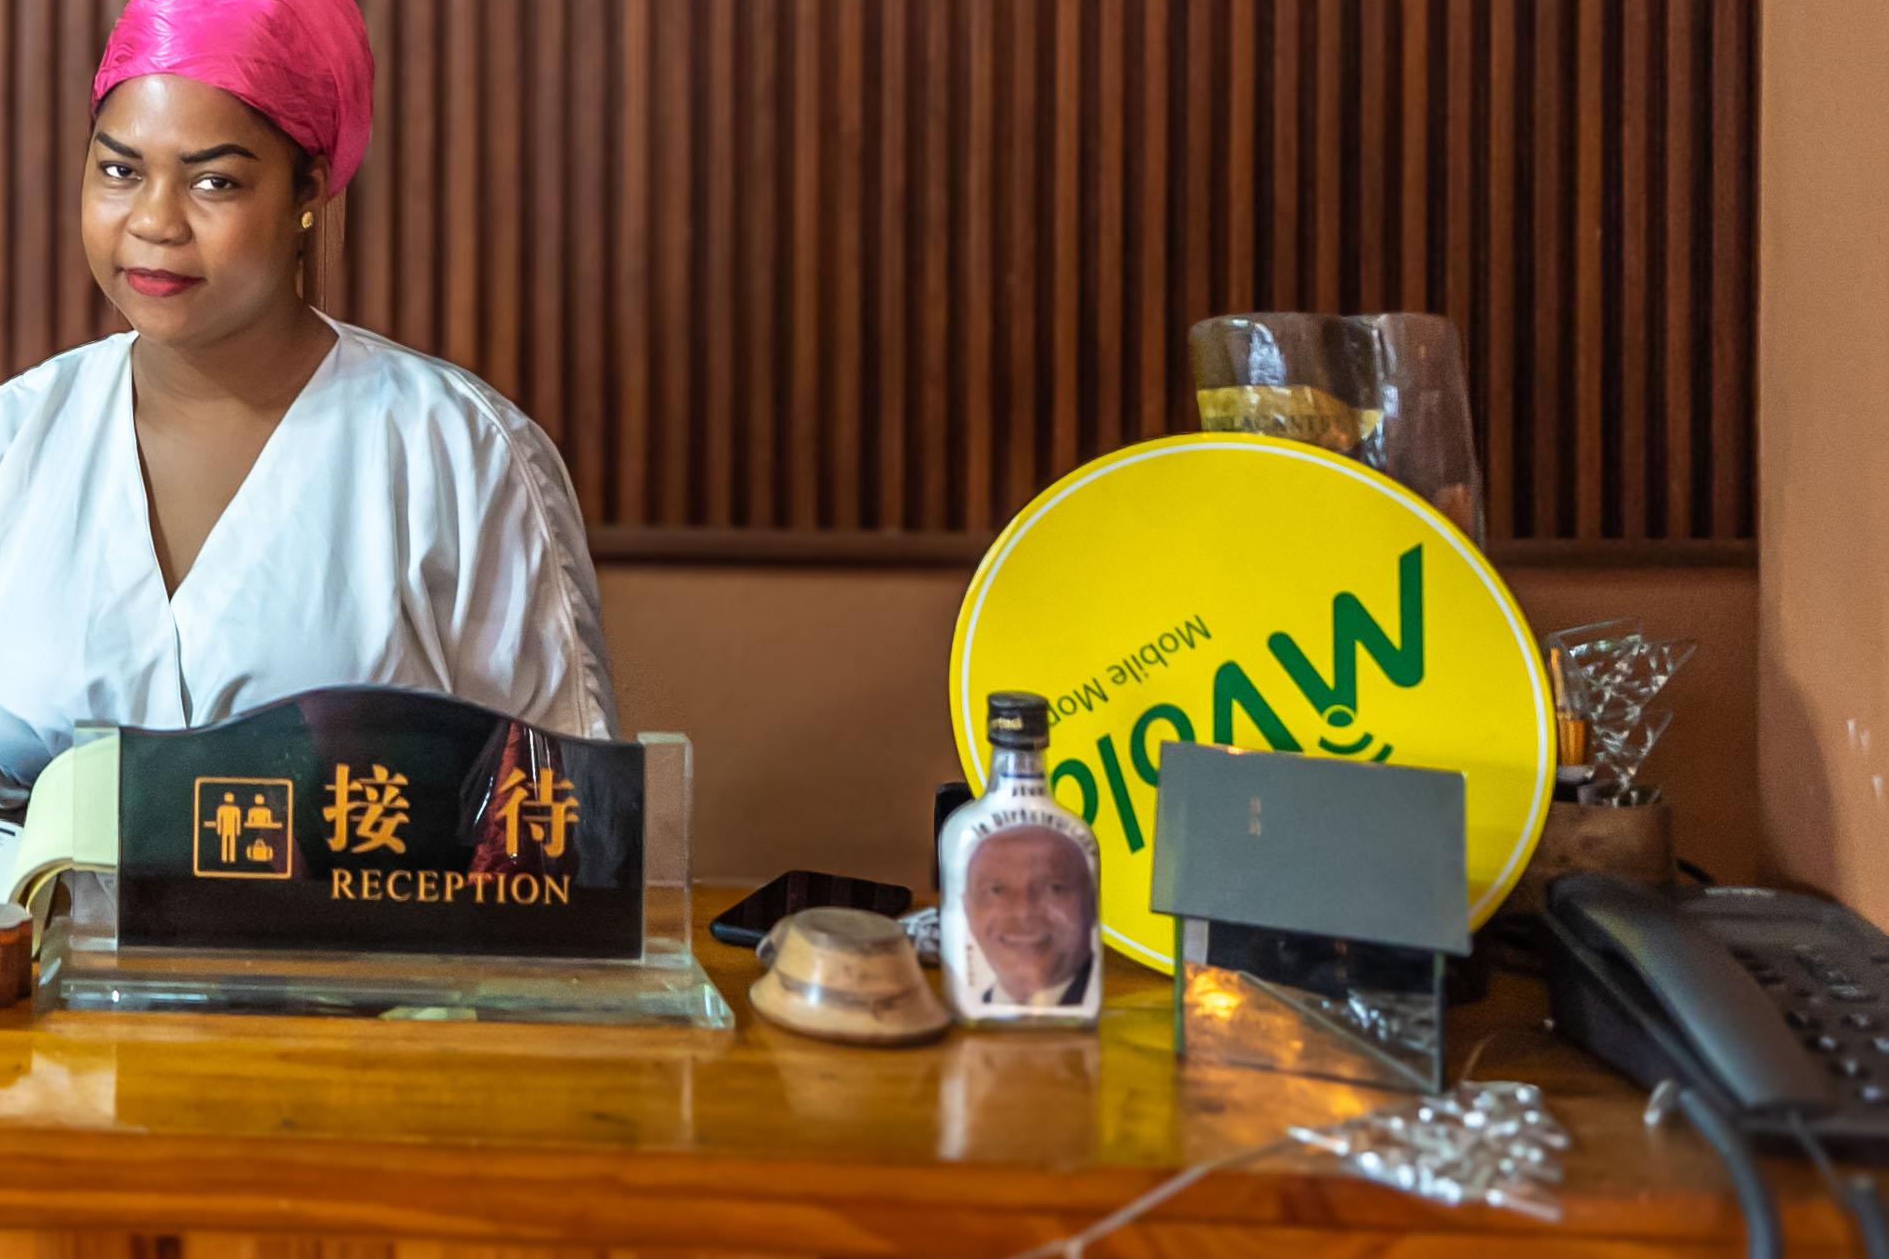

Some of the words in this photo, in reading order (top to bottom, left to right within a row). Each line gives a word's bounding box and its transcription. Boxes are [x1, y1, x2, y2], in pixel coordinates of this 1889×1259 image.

[1110, 614, 1212, 687] Mobile
[323, 763, 579, 857] 接待
[330, 867, 572, 905] RECEPTION
